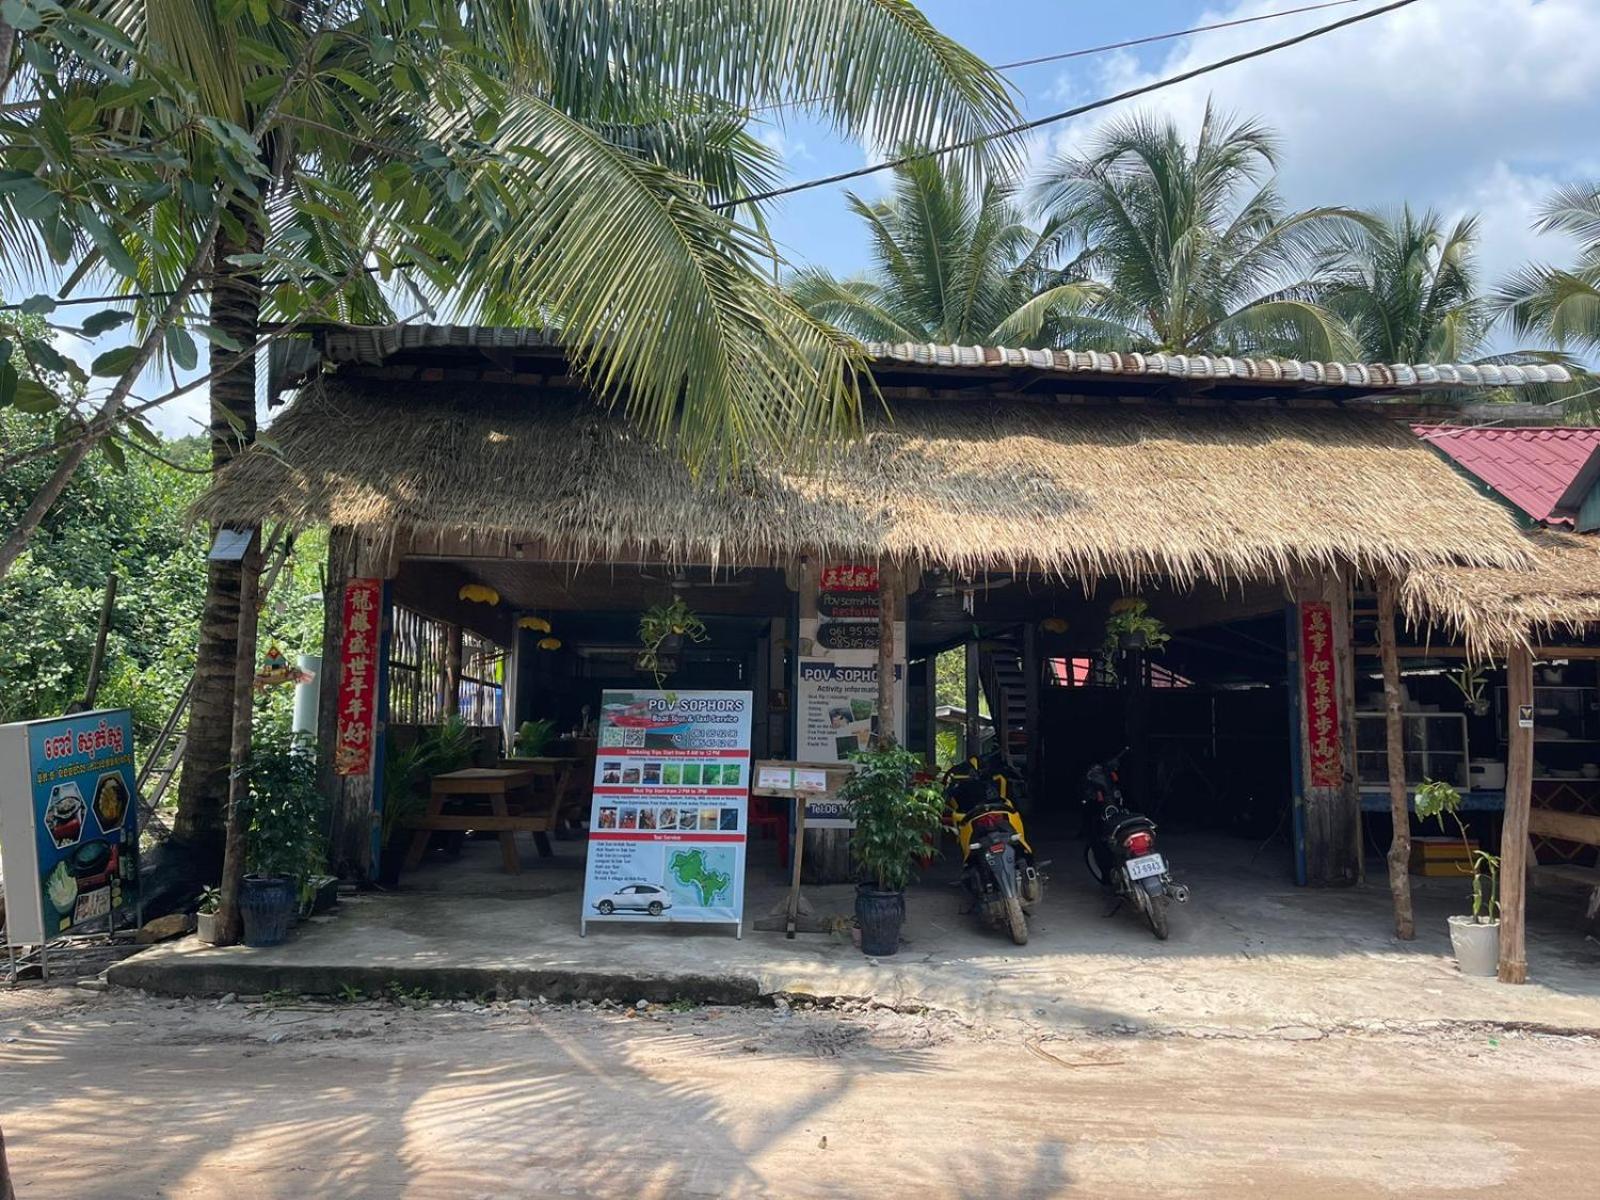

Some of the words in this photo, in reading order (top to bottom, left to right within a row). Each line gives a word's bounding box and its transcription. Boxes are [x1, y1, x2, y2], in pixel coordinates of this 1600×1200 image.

[804, 669, 831, 681] POV
[836, 669, 897, 682] SOPHO
[817, 686, 842, 694] Activity
[648, 699, 676, 711] POV
[680, 699, 744, 712] SOPHORS
[651, 714, 669, 722] Boat
[687, 714, 694, 723] &
[711, 715, 739, 723] Service
